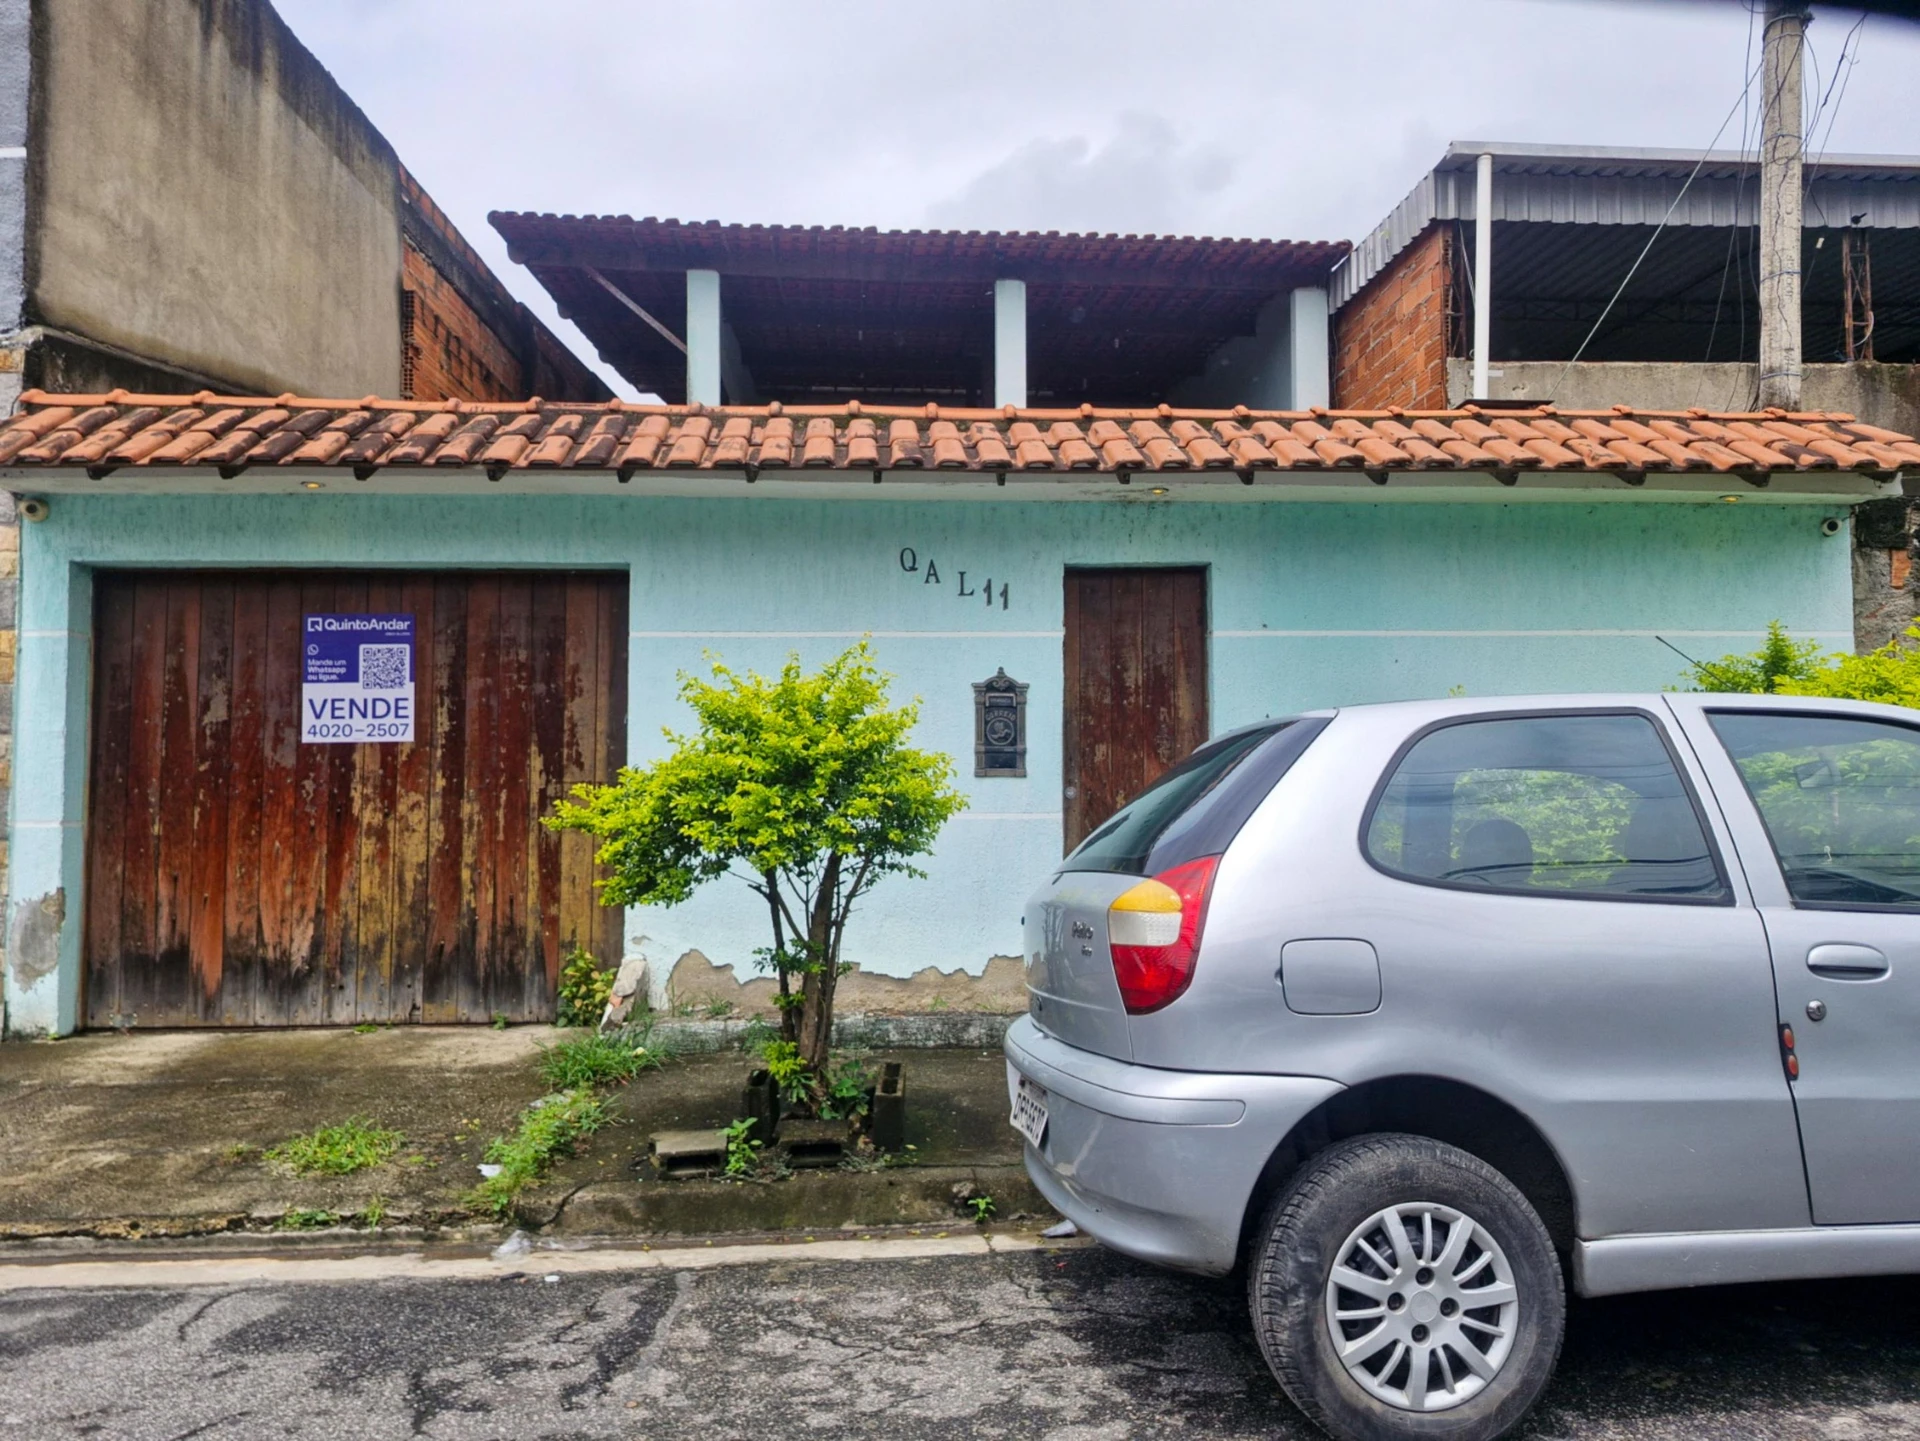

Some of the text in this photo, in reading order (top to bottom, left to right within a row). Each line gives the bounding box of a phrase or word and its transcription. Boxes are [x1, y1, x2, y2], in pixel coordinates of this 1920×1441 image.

[324, 618, 411, 631] QuintoAndar
[307, 658, 333, 666] Mande
[307, 666, 347, 675] Whatsapp
[318, 673, 340, 682] ligue.
[308, 698, 410, 720] VENDE
[307, 723, 410, 738] 4020-2507
